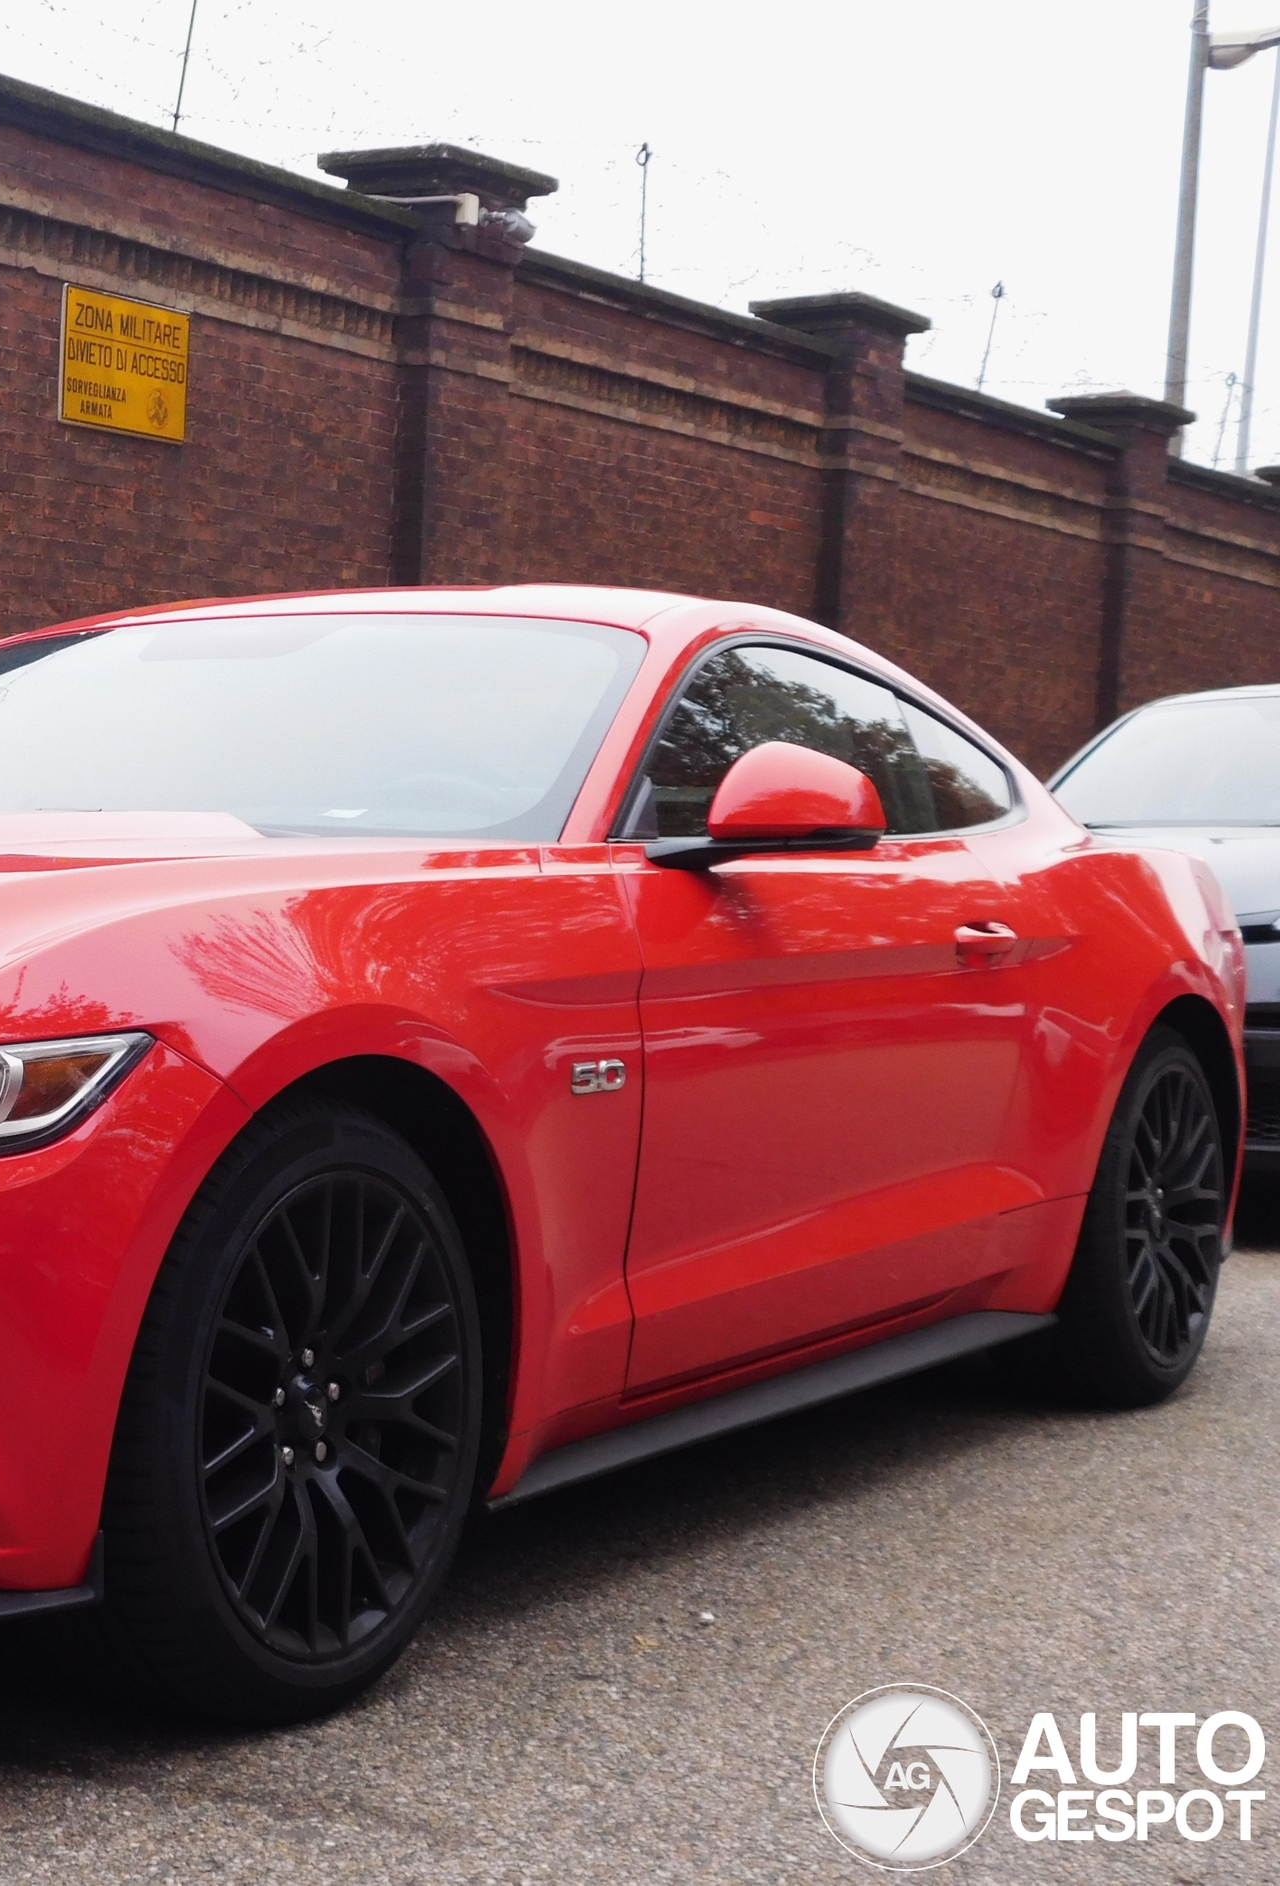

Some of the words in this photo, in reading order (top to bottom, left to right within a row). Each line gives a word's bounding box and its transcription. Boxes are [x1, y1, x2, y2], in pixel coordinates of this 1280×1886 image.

[75, 302, 113, 334] ZONA
[120, 313, 181, 349] MILITARE
[67, 337, 112, 368] DIVIETO
[116, 348, 127, 373] DI
[130, 352, 185, 384] ACCESSO
[66, 376, 127, 403] SORVEGLIANZA
[79, 400, 113, 419] ARMATA
